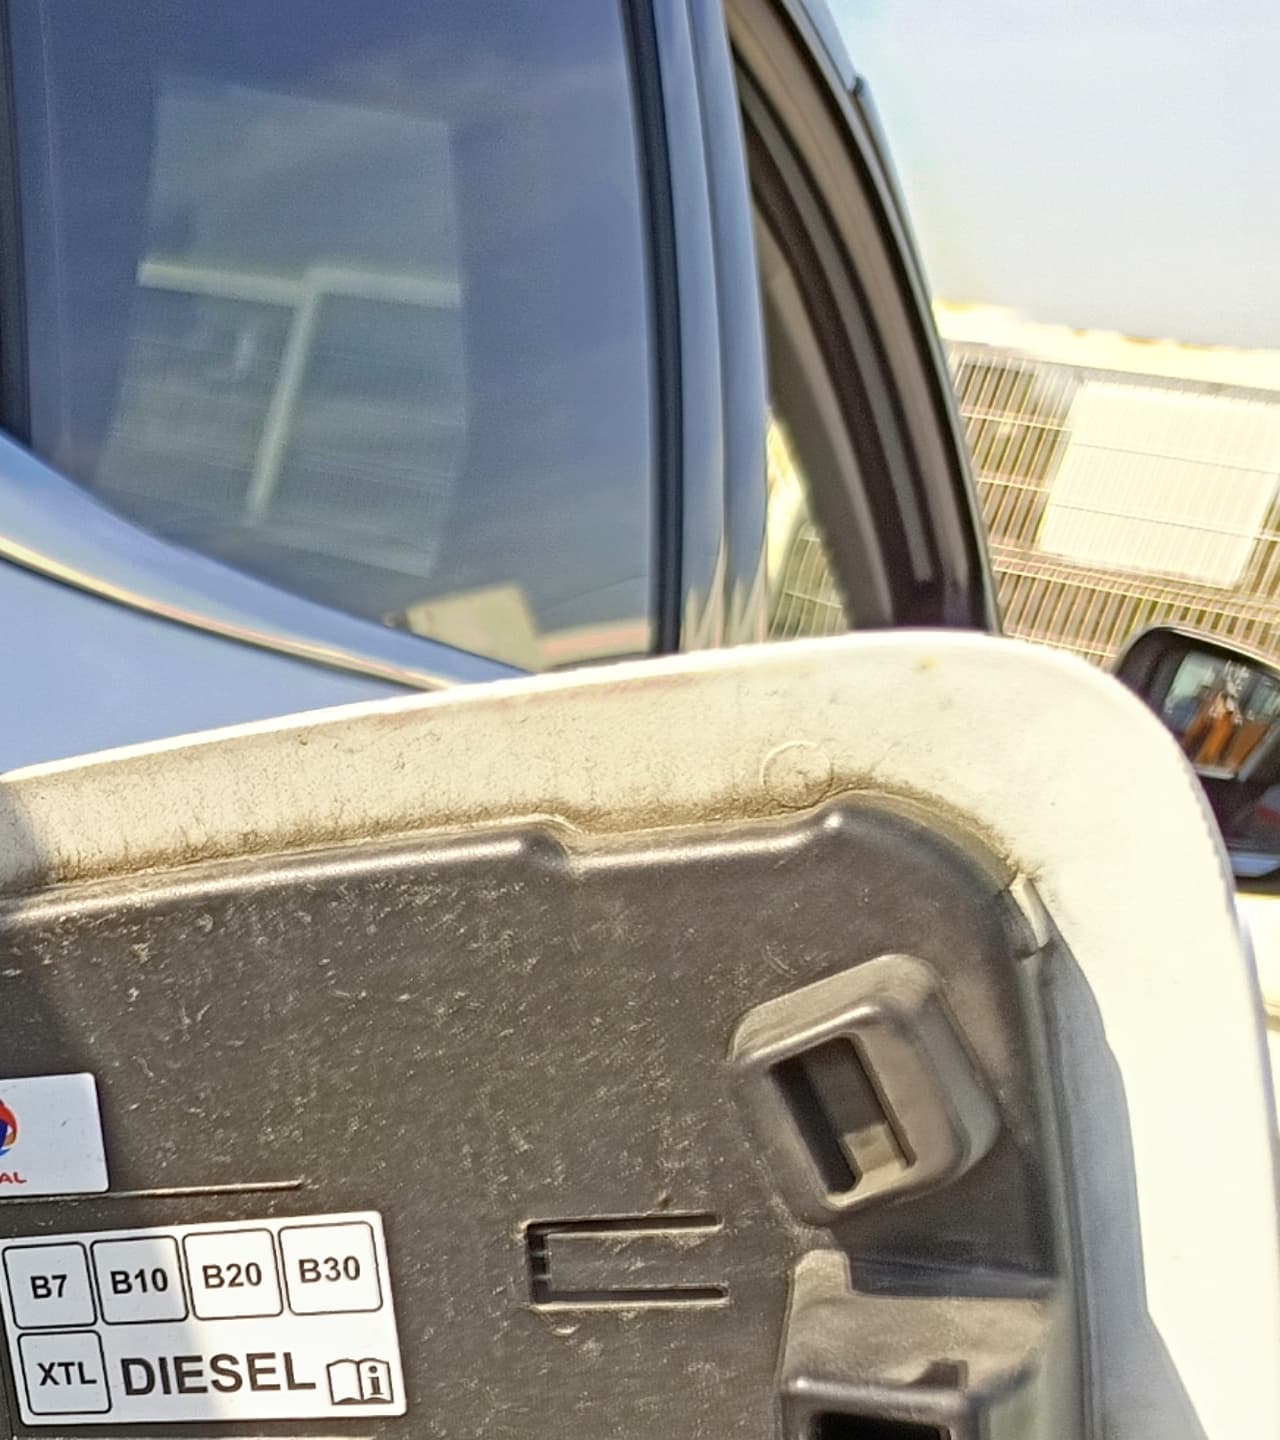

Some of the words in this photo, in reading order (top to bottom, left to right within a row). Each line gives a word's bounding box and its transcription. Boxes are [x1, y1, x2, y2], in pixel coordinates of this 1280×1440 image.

[30, 1274, 68, 1299] B7
[111, 1267, 169, 1294] B10
[202, 1261, 263, 1289] B20
[298, 1255, 361, 1283] B30
[38, 1360, 98, 1386] XTL
[120, 1350, 317, 1396] DIESEL
